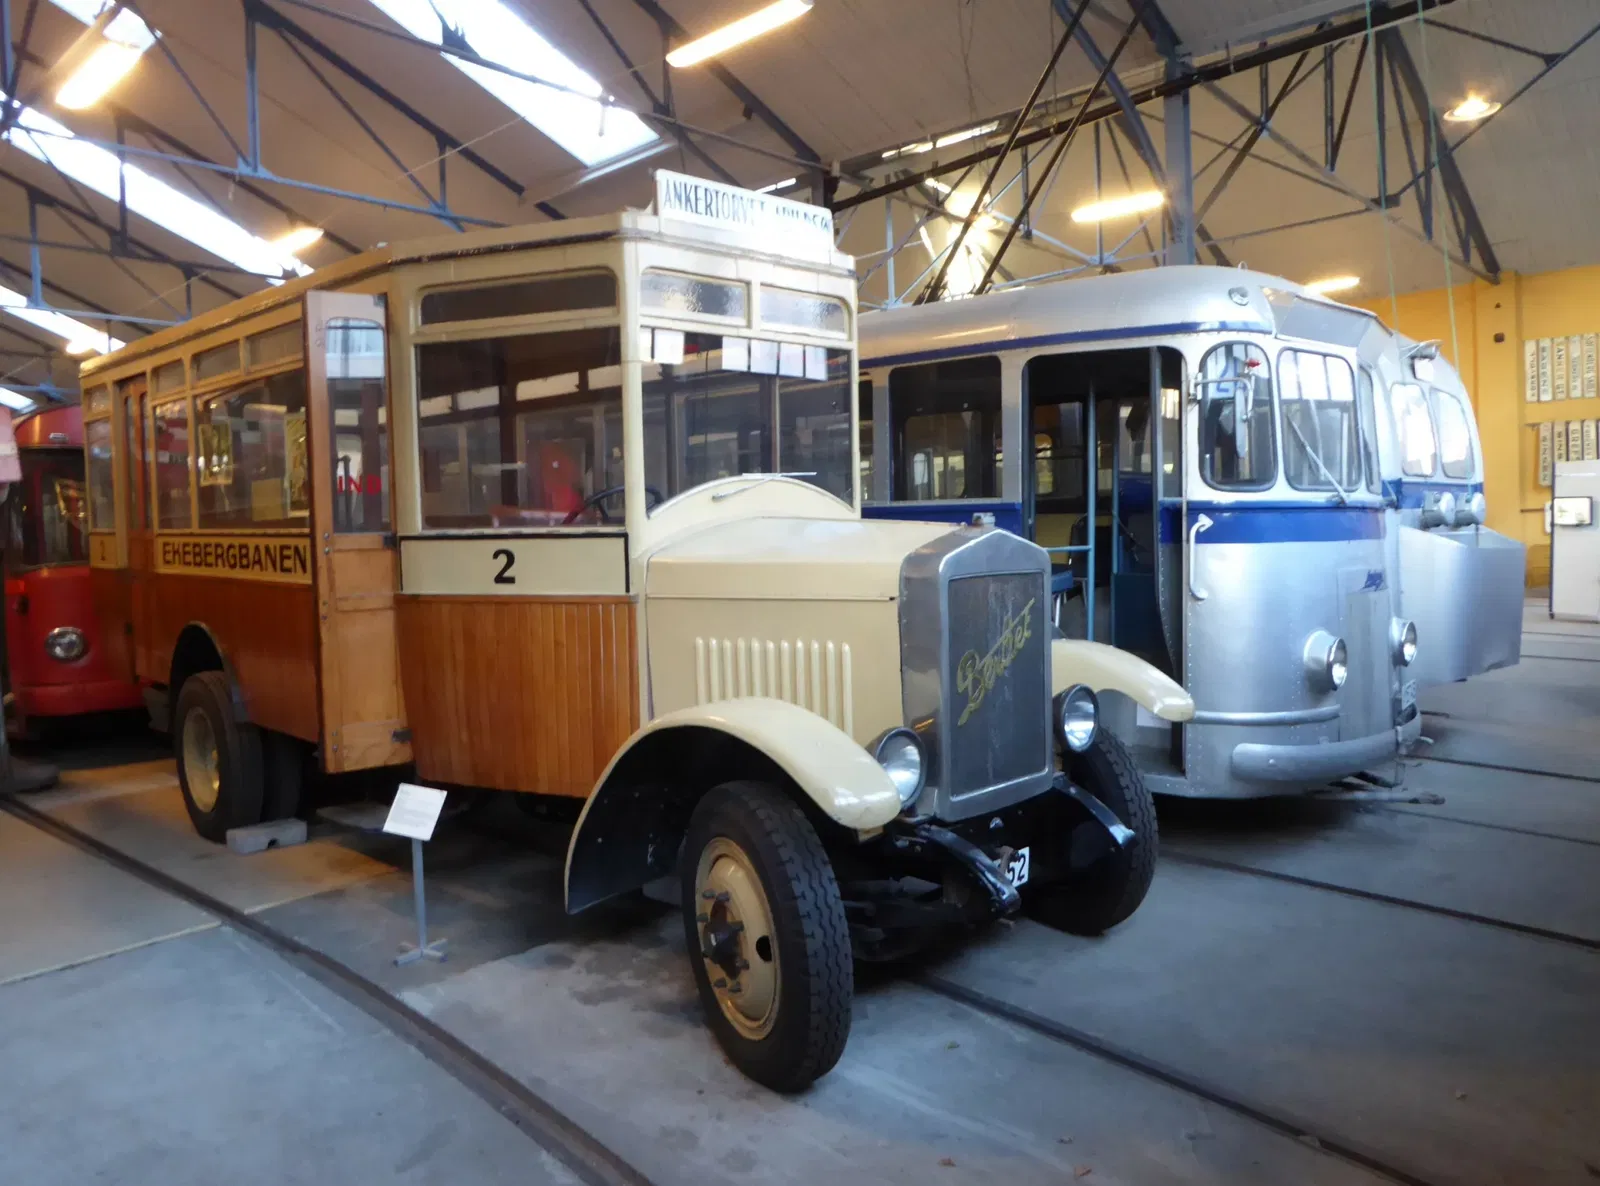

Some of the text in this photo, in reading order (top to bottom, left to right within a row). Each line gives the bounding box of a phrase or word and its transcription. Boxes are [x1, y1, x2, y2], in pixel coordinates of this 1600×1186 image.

[337, 473, 383, 497] IND
[162, 541, 308, 576] EKEBERGBANEN
[492, 548, 516, 585] 2
